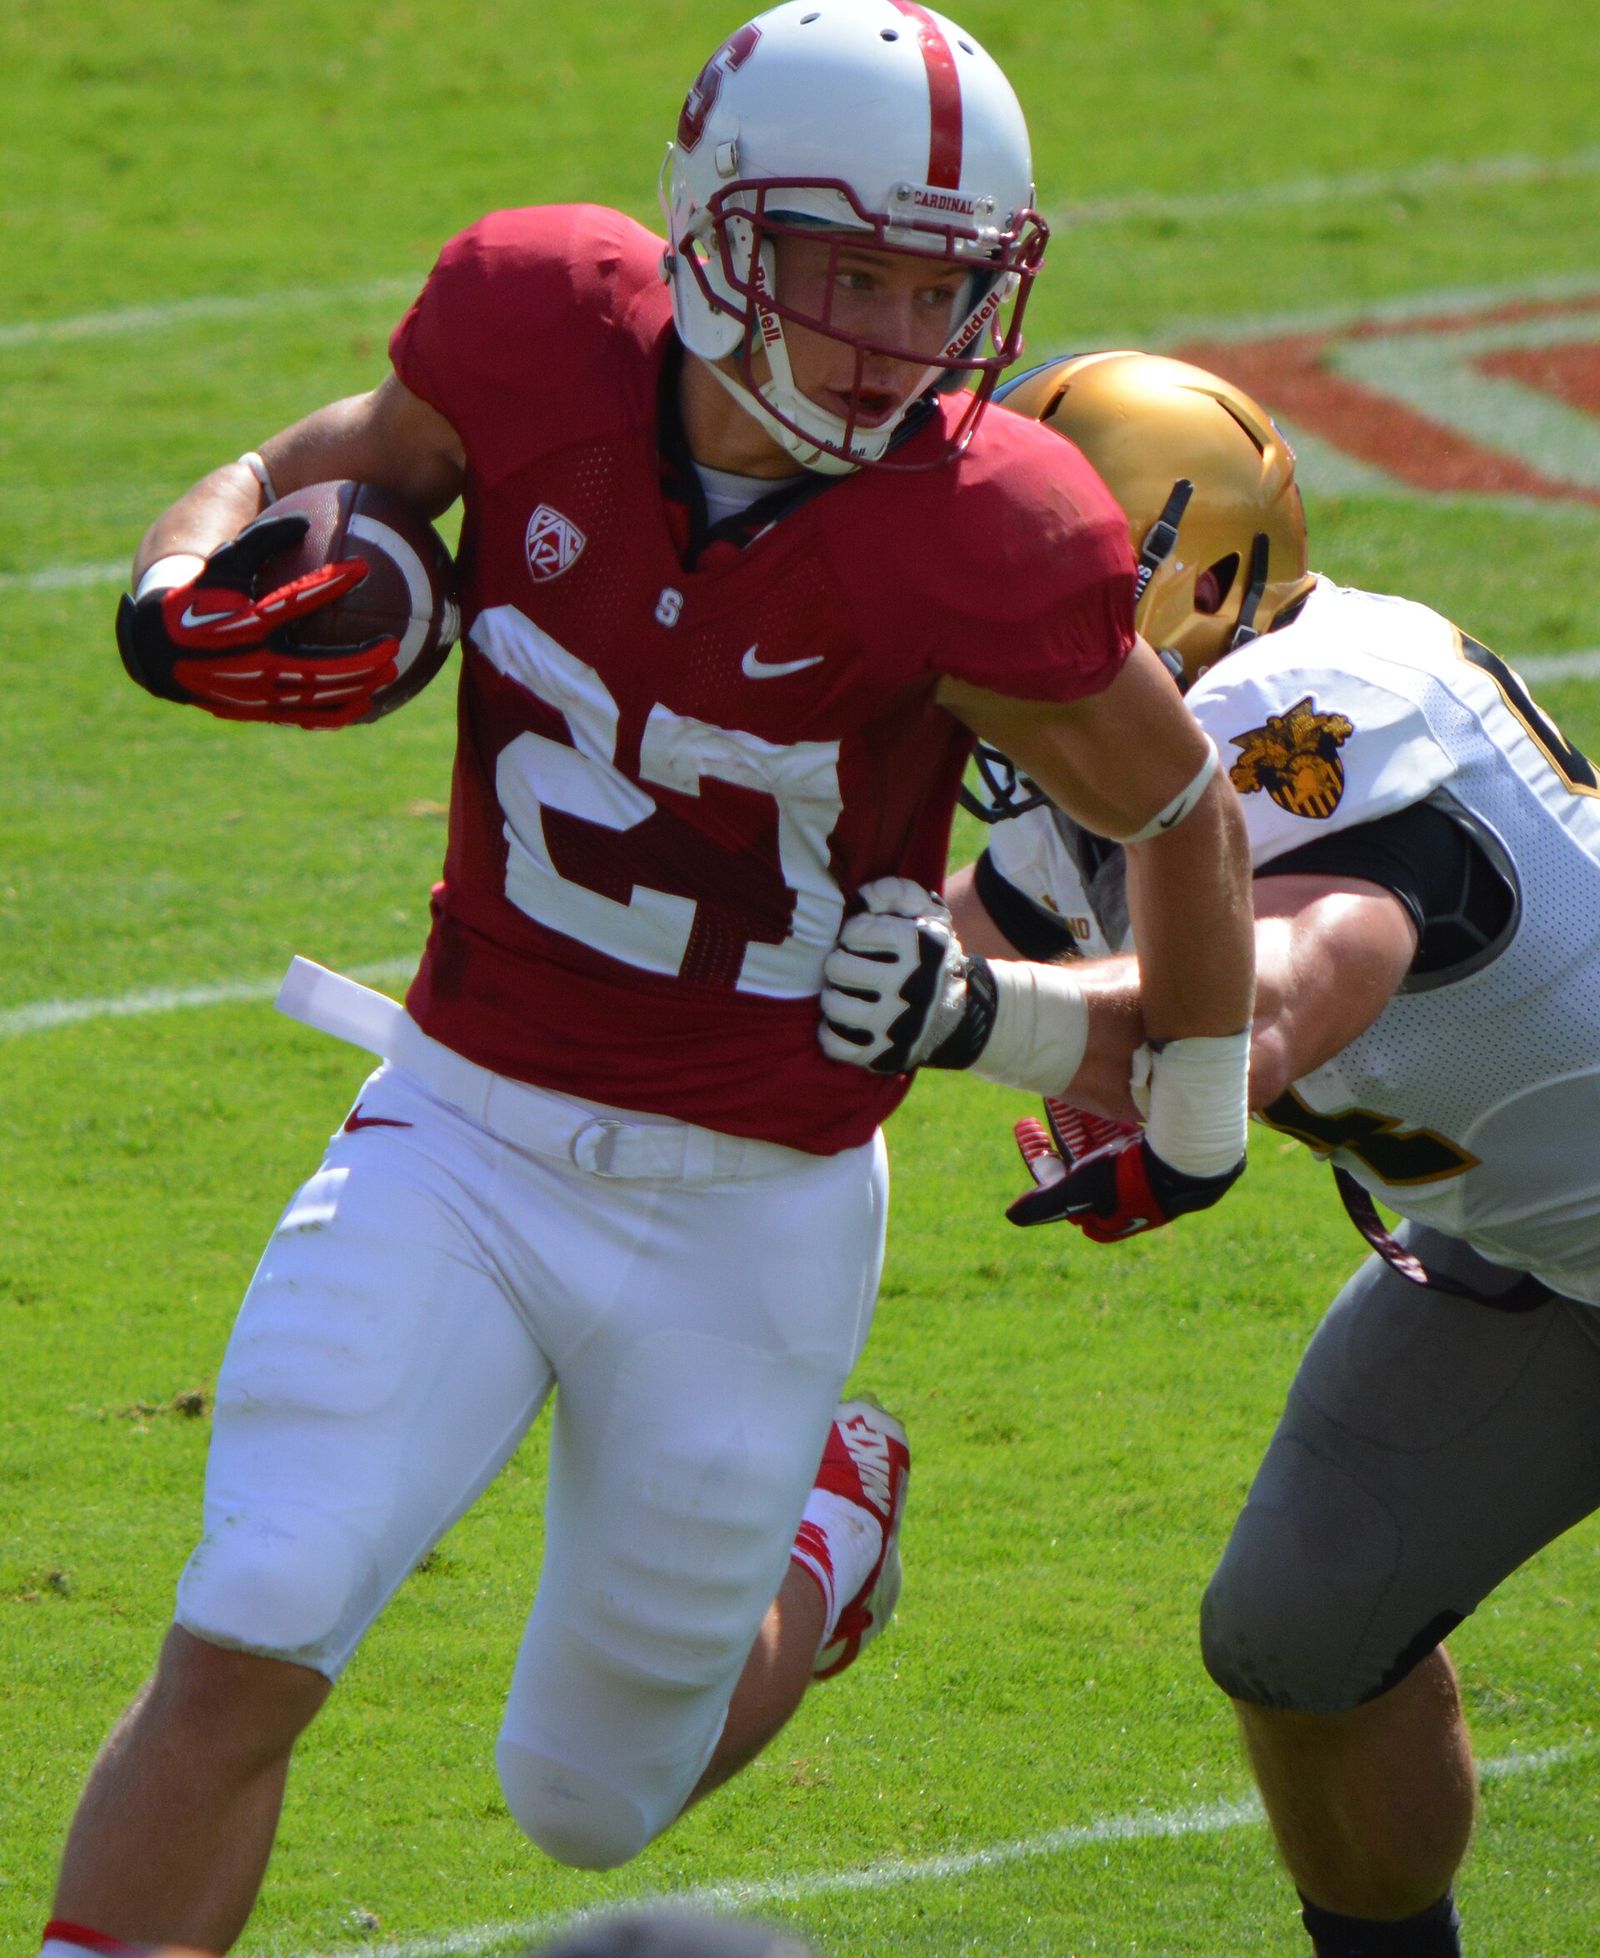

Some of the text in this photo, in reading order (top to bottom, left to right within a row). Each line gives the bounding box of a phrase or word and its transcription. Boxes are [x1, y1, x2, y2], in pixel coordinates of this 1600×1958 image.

[914, 190, 975, 216] CARDINAL
[753, 265, 782, 341] Ridell
[945, 291, 1001, 359] Riddell
[528, 508, 584, 568] PAC
[530, 538, 560, 575] 12
[655, 587, 684, 628] S
[835, 1419, 891, 1517] NIKE
